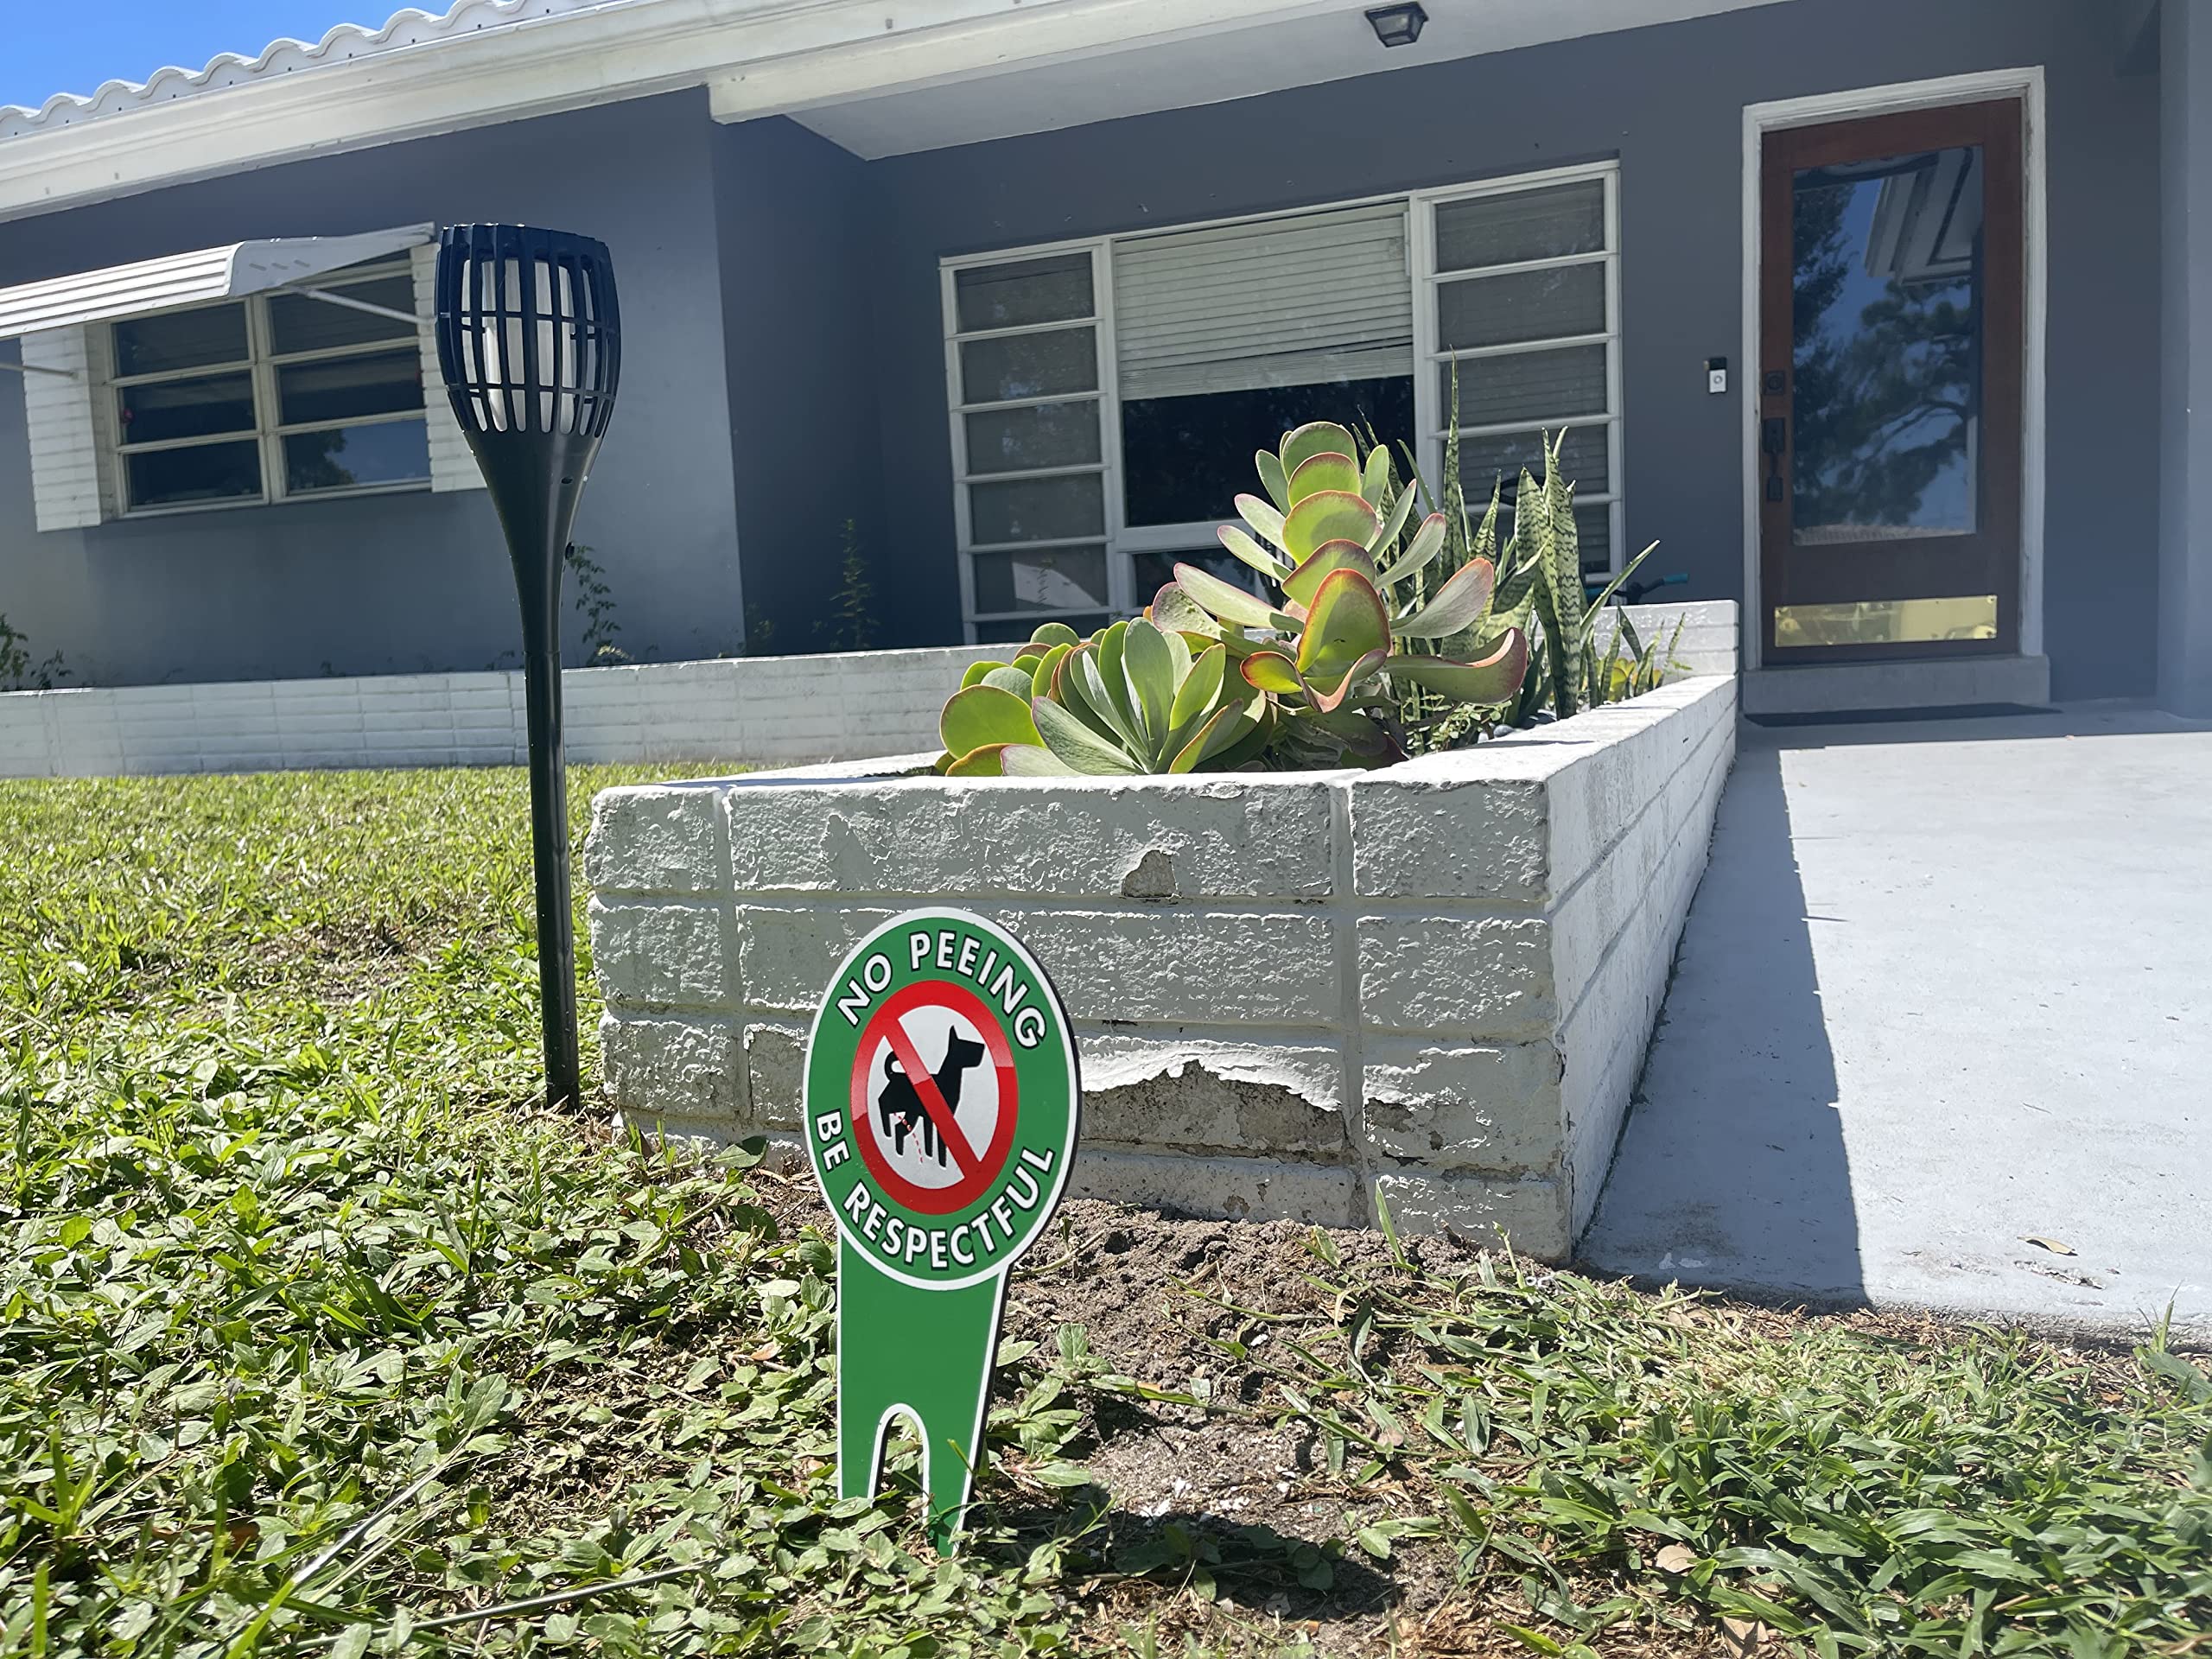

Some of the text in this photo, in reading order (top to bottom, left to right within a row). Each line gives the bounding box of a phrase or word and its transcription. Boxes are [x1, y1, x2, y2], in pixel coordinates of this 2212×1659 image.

[837, 931, 1046, 1048] NO PEEING
[817, 1109, 1054, 1268] BE RESPECTFUL
